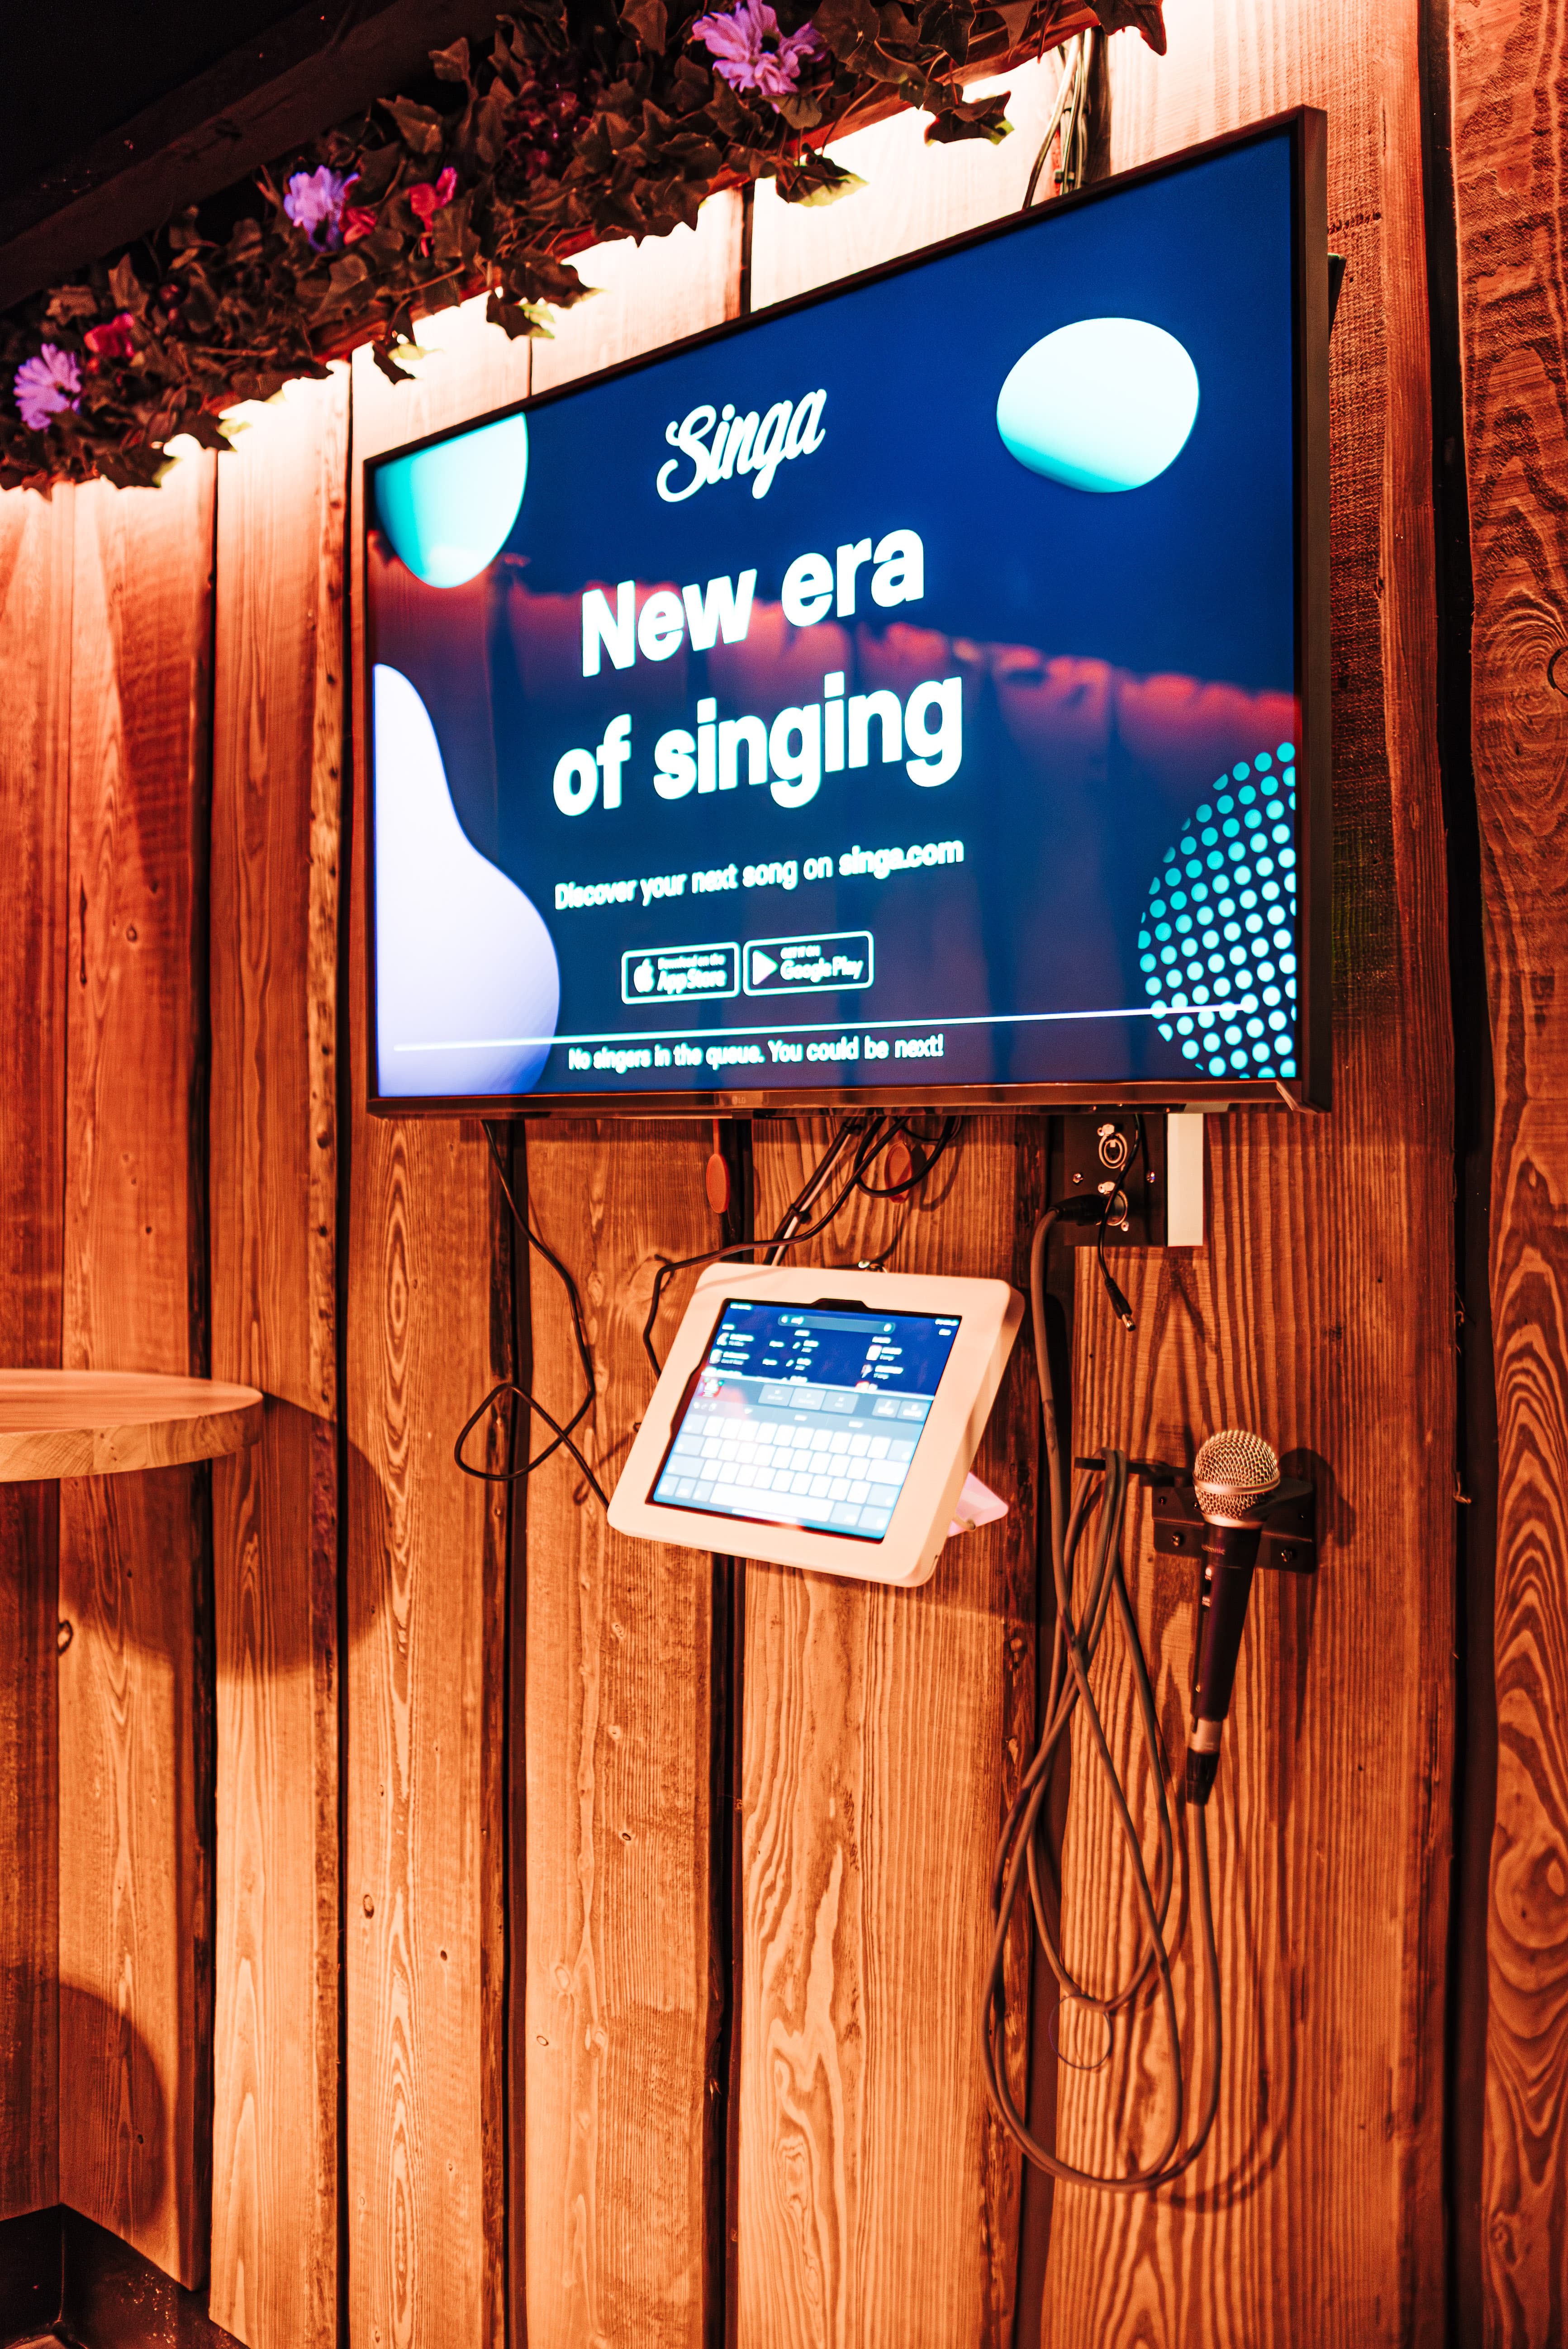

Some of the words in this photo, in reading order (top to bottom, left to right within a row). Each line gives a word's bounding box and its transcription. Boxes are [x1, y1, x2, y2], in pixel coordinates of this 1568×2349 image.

[656, 389, 827, 502] Singa
[582, 569, 757, 677] New
[781, 529, 924, 628] era
[553, 714, 632, 816] of
[654, 671, 962, 808] singing
[555, 880, 637, 910] Discover
[640, 874, 687, 907] your
[691, 864, 738, 894] next
[742, 861, 798, 890] song
[803, 856, 832, 880] on
[838, 840, 964, 880] singa.com
[657, 970, 687, 994] App
[687, 968, 727, 989] Store
[780, 957, 832, 983] Google
[832, 956, 864, 980] Play
[568, 1049, 591, 1070] No
[593, 1047, 651, 1074] singers
[654, 1045, 670, 1067] in
[673, 1043, 703, 1066] the
[705, 1046, 765, 1070] queue.
[767, 1040, 802, 1063] You
[806, 1036, 859, 1061] could
[864, 1035, 889, 1060] be
[894, 1033, 944, 1058] next!
